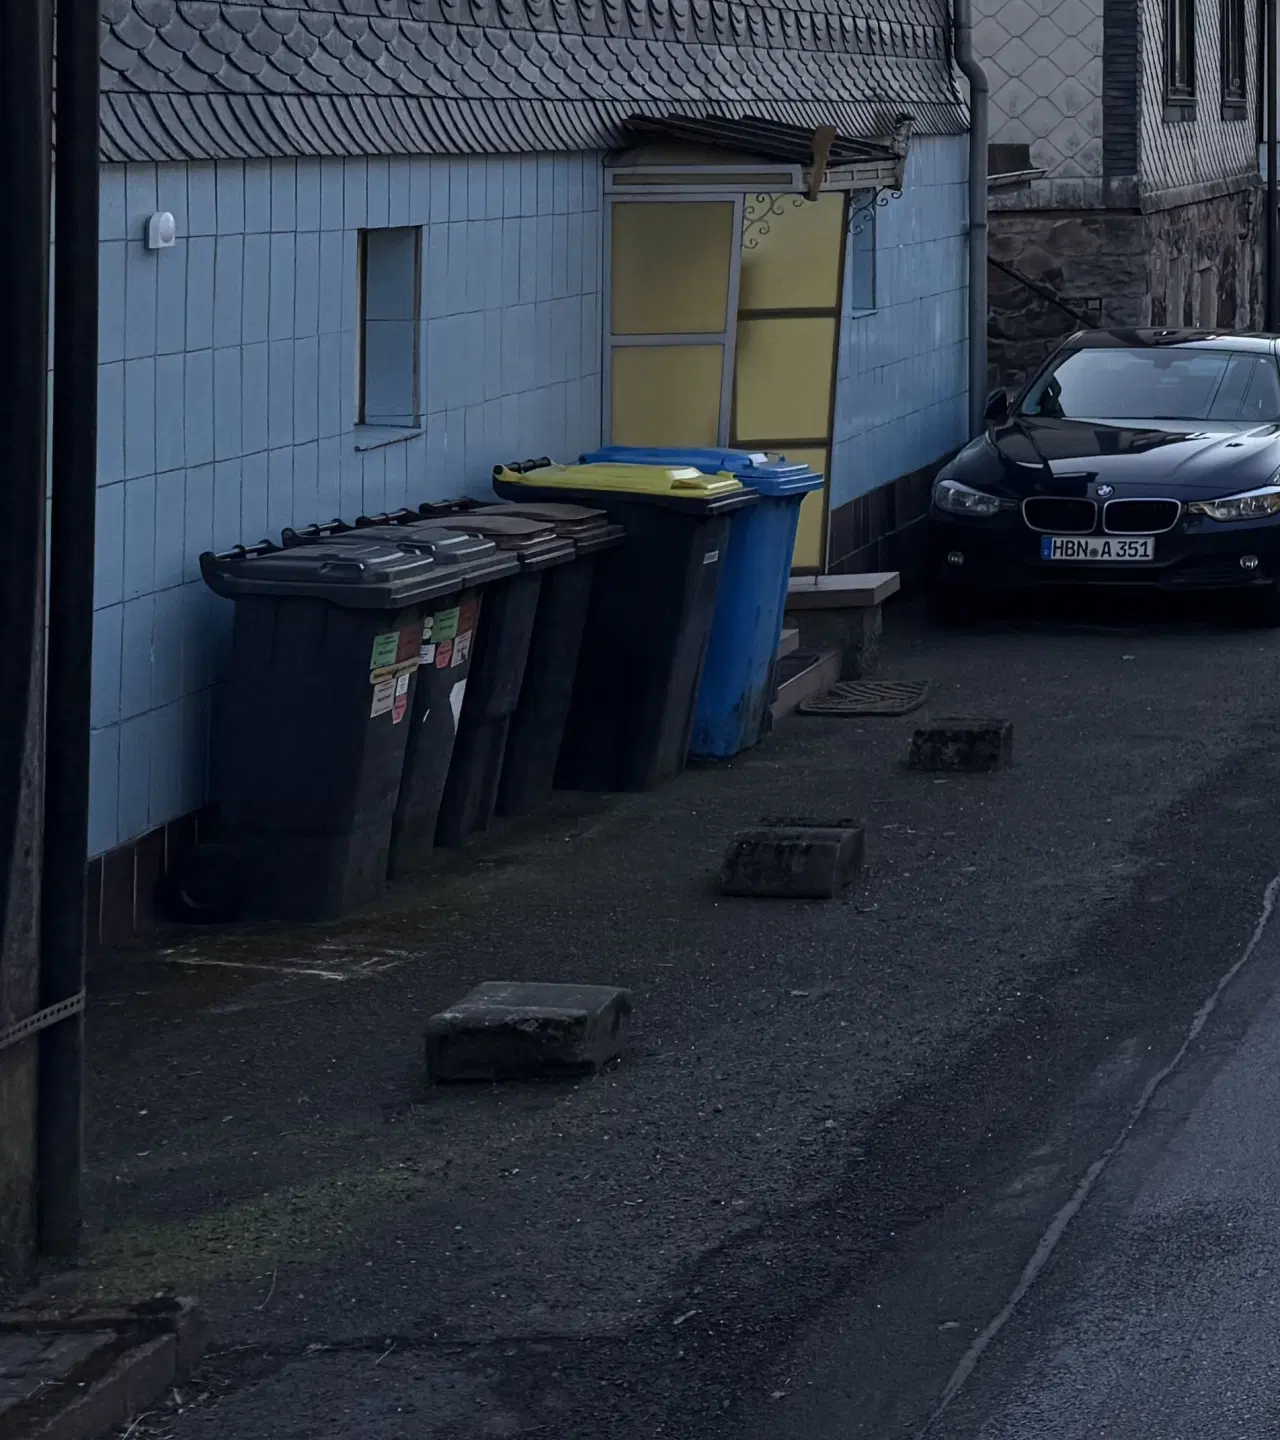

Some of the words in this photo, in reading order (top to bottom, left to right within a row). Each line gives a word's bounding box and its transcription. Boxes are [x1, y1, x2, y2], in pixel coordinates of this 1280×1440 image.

[1052, 539, 1089, 557] HBN
[1100, 541, 1112, 558] A
[1116, 541, 1150, 558] 351
